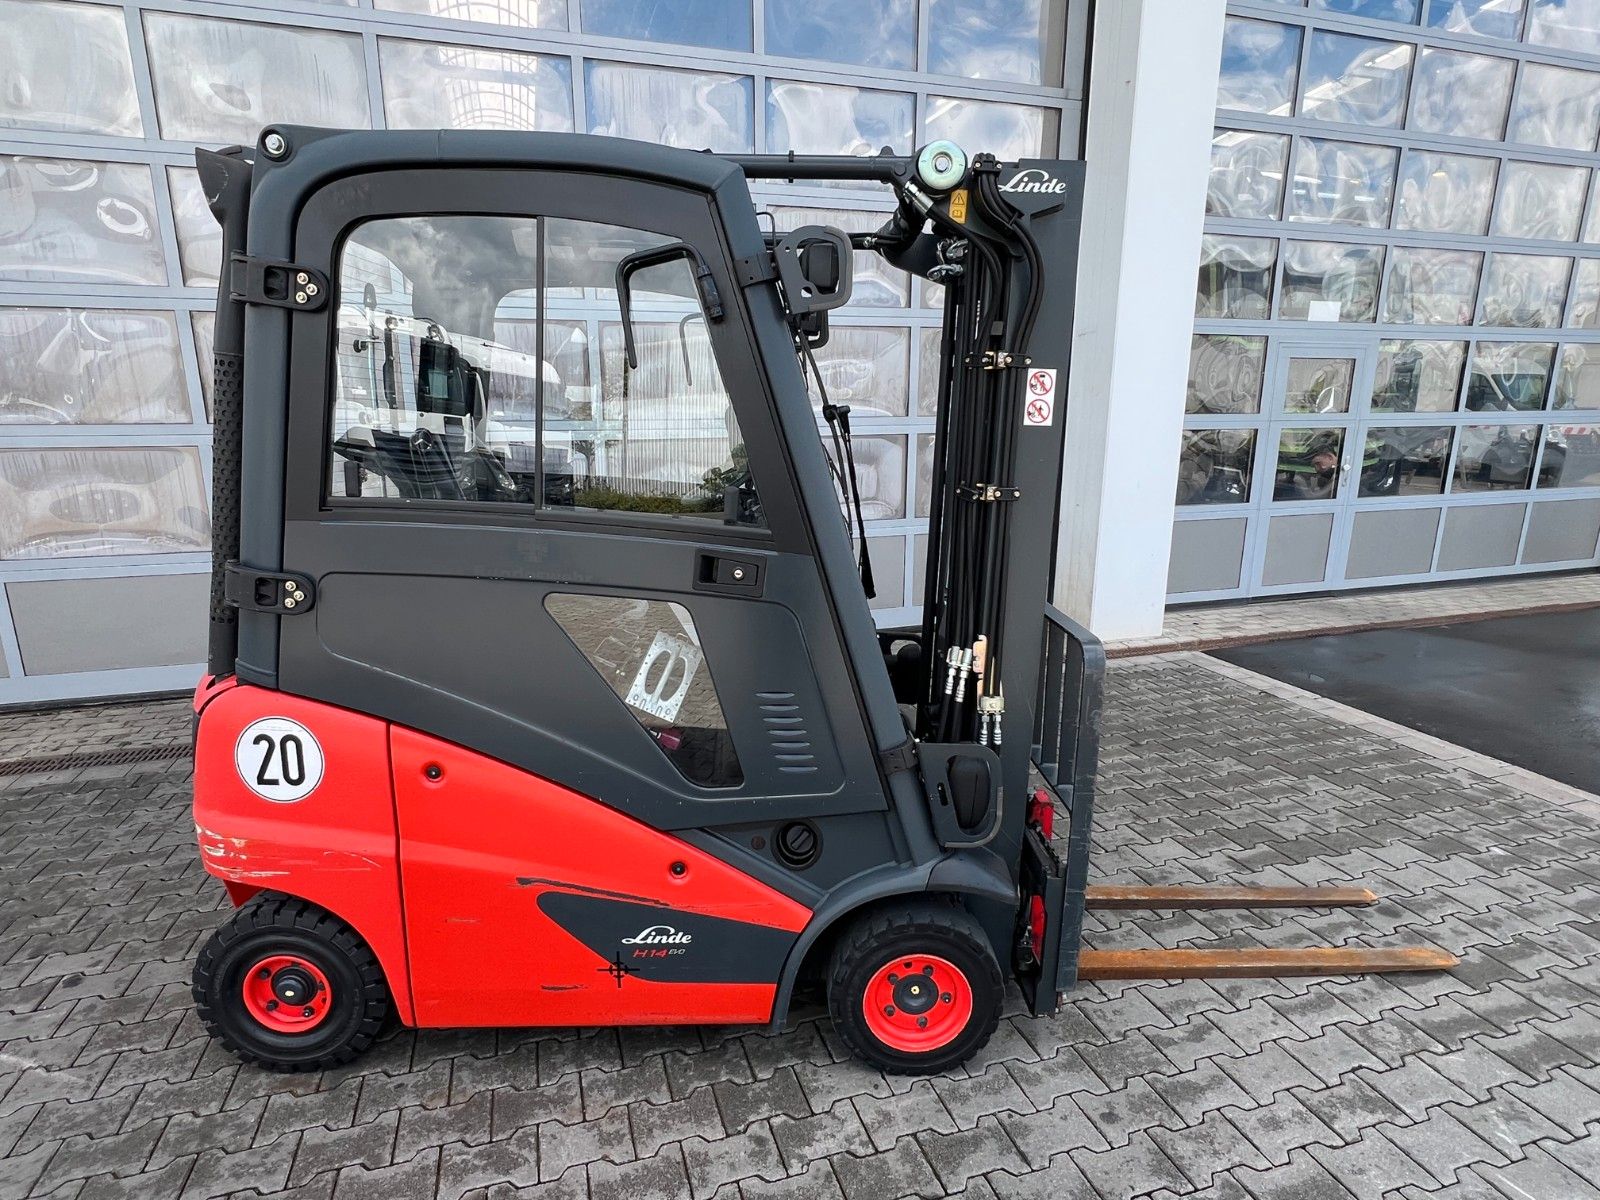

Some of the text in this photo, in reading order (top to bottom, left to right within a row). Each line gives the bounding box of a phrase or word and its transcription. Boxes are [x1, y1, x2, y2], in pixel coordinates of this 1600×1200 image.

[997, 169, 1066, 193] Linde
[252, 733, 305, 786] 20
[621, 925, 692, 944] Linde
